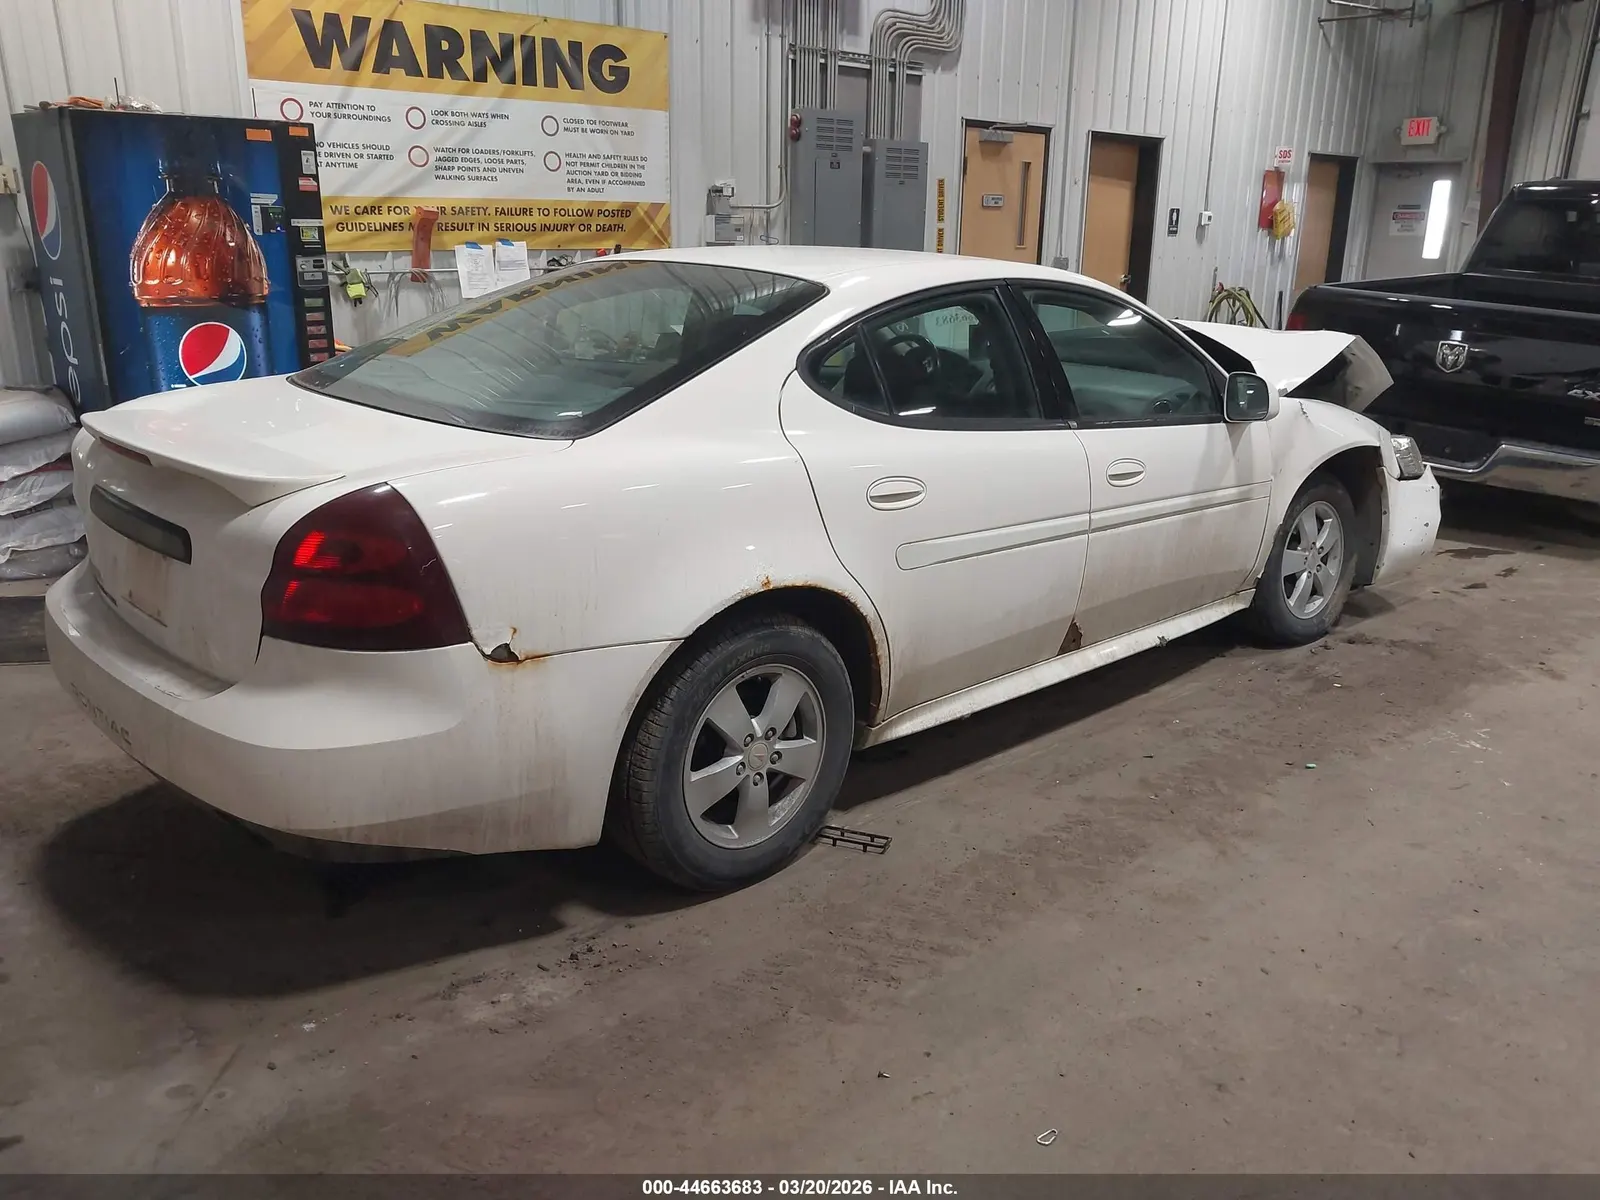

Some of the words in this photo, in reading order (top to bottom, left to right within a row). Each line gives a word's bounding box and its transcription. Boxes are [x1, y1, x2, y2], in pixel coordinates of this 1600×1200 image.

[291, 8, 630, 94] WARNING
[326, 102, 364, 111] ATTENTION
[334, 112, 391, 122] SURROUNDINGS
[1408, 119, 1432, 137] EXIT
[1279, 149, 1292, 159] SDS
[330, 205, 349, 215] WE
[355, 206, 382, 216] CARE
[388, 206, 411, 216] FOR
[451, 205, 490, 216] SAFETY.
[495, 207, 533, 216] FAILURE
[537, 208, 550, 216] TO
[554, 208, 593, 217] FOLLOW
[597, 209, 631, 218] POSTED
[336, 222, 404, 232] GUIDELINES
[438, 222, 474, 232] RESULT
[478, 222, 489, 232] IN
[494, 223, 536, 232] SERIOUS
[540, 223, 575, 232] INJURY
[578, 224, 591, 232] OR
[596, 224, 626, 232] DEATH.
[50, 276, 81, 404] epsi
